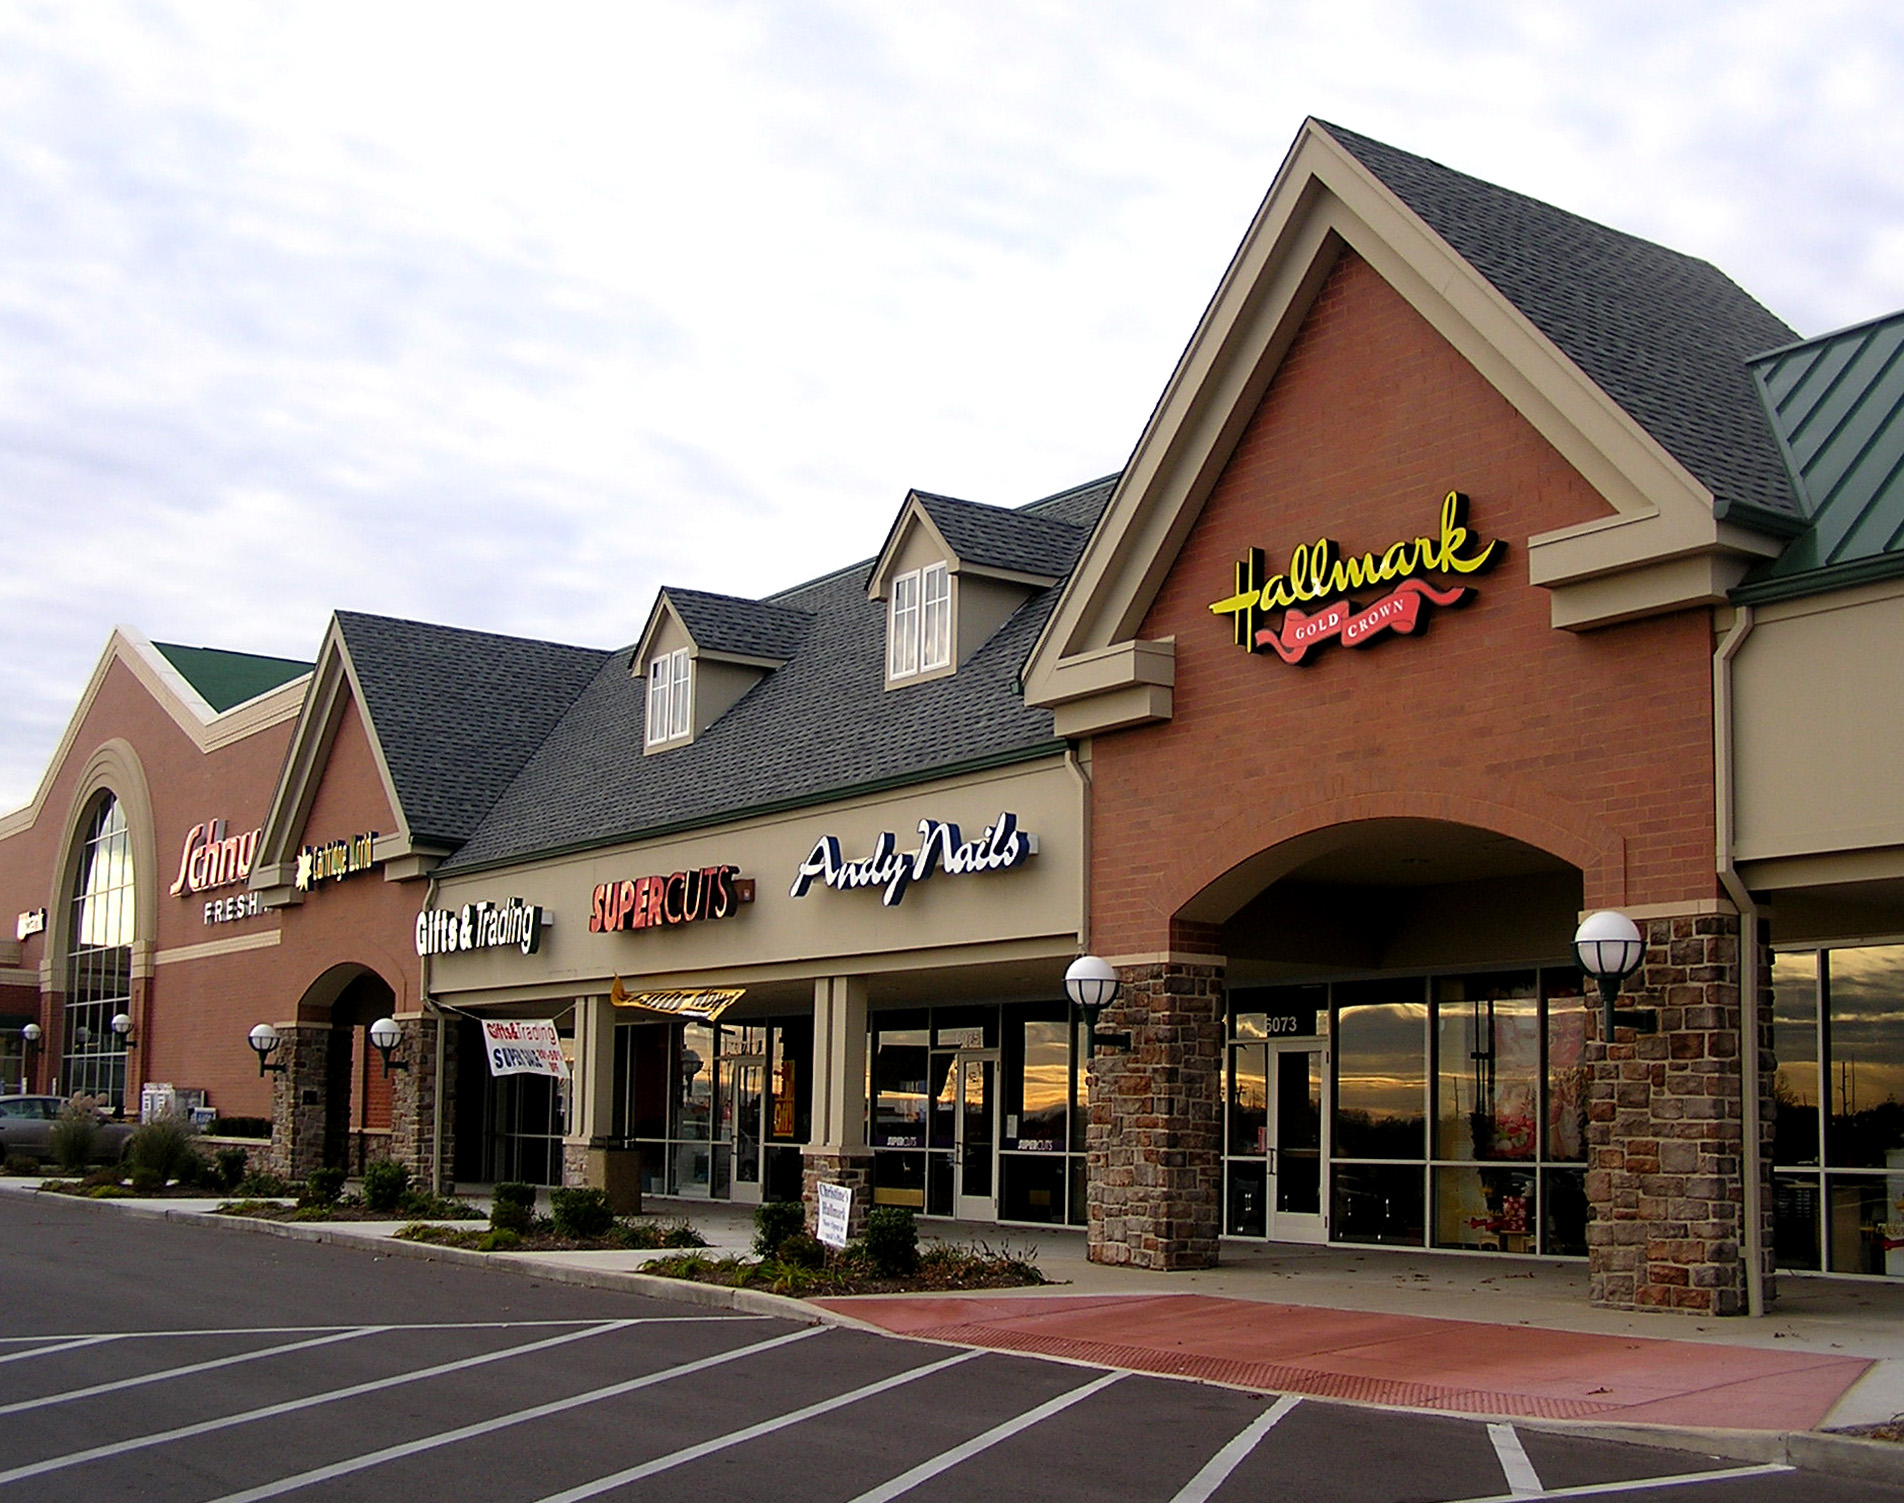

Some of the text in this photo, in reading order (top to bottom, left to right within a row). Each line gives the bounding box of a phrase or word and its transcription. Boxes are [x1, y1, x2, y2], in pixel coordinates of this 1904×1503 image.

[1209, 491, 1497, 653] Hallmark
[1295, 599, 1405, 640] GOLD CROWN
[790, 812, 1022, 907] Andy Nails
[204, 892, 259, 924] FRESH
[416, 897, 535, 956] Gifts & Trading
[589, 865, 730, 933] SUPERCUTS
[1266, 1017, 1297, 1032] 6073
